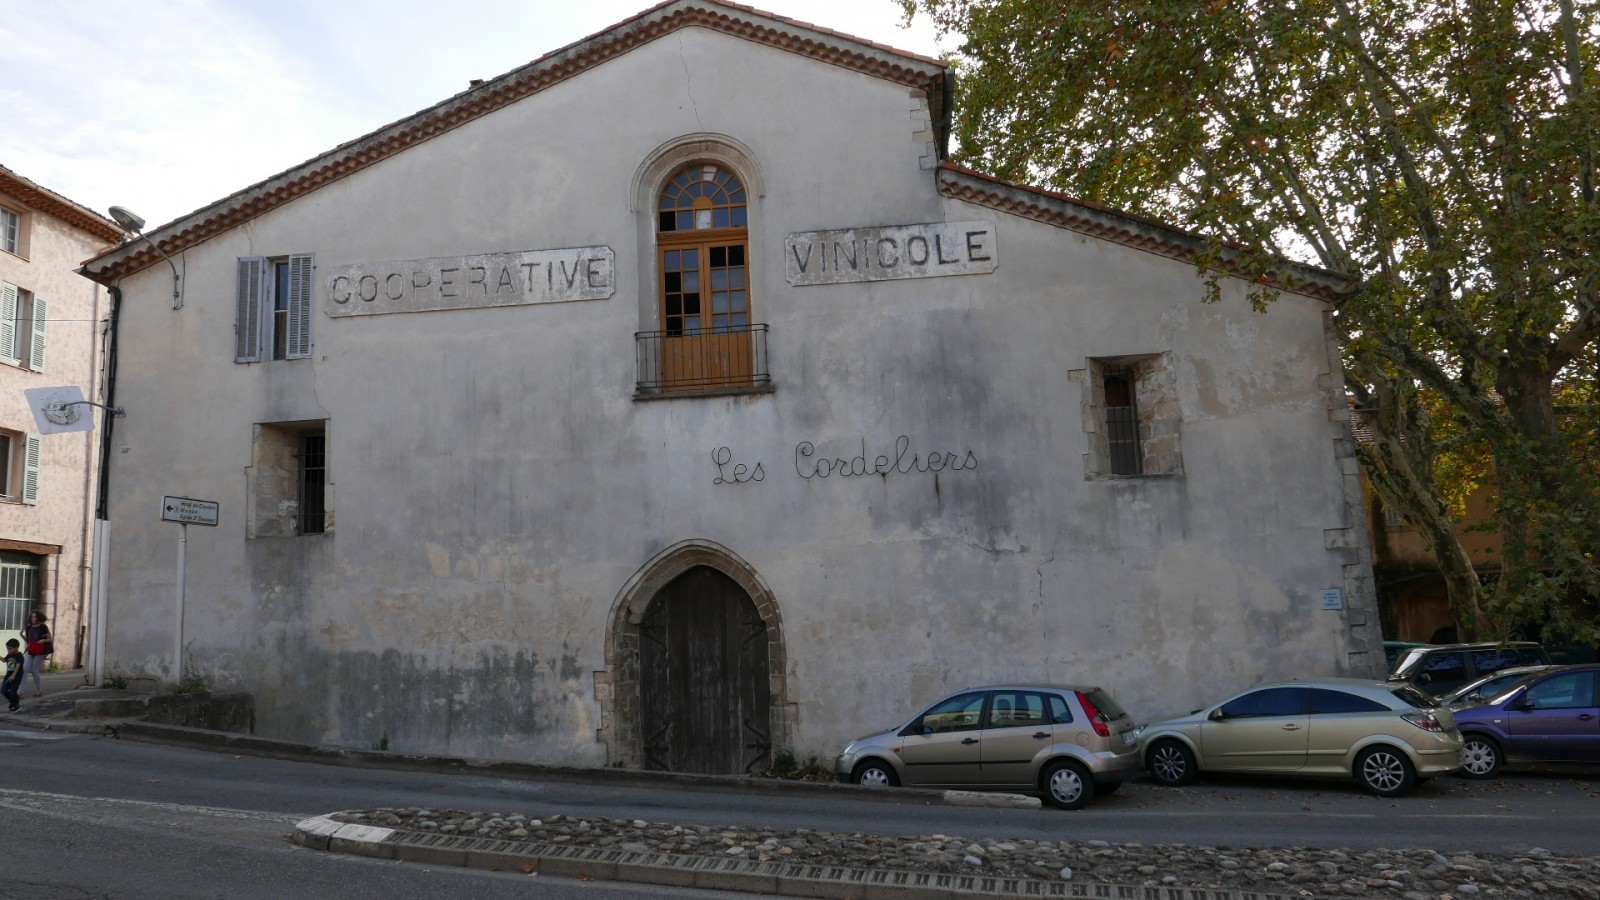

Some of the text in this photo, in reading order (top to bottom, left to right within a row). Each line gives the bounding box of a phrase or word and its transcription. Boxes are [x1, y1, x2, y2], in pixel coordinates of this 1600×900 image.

[792, 230, 991, 273] VINICOLE
[332, 257, 609, 305] COOPERATIVE
[711, 435, 978, 485] Les Cordeliers
